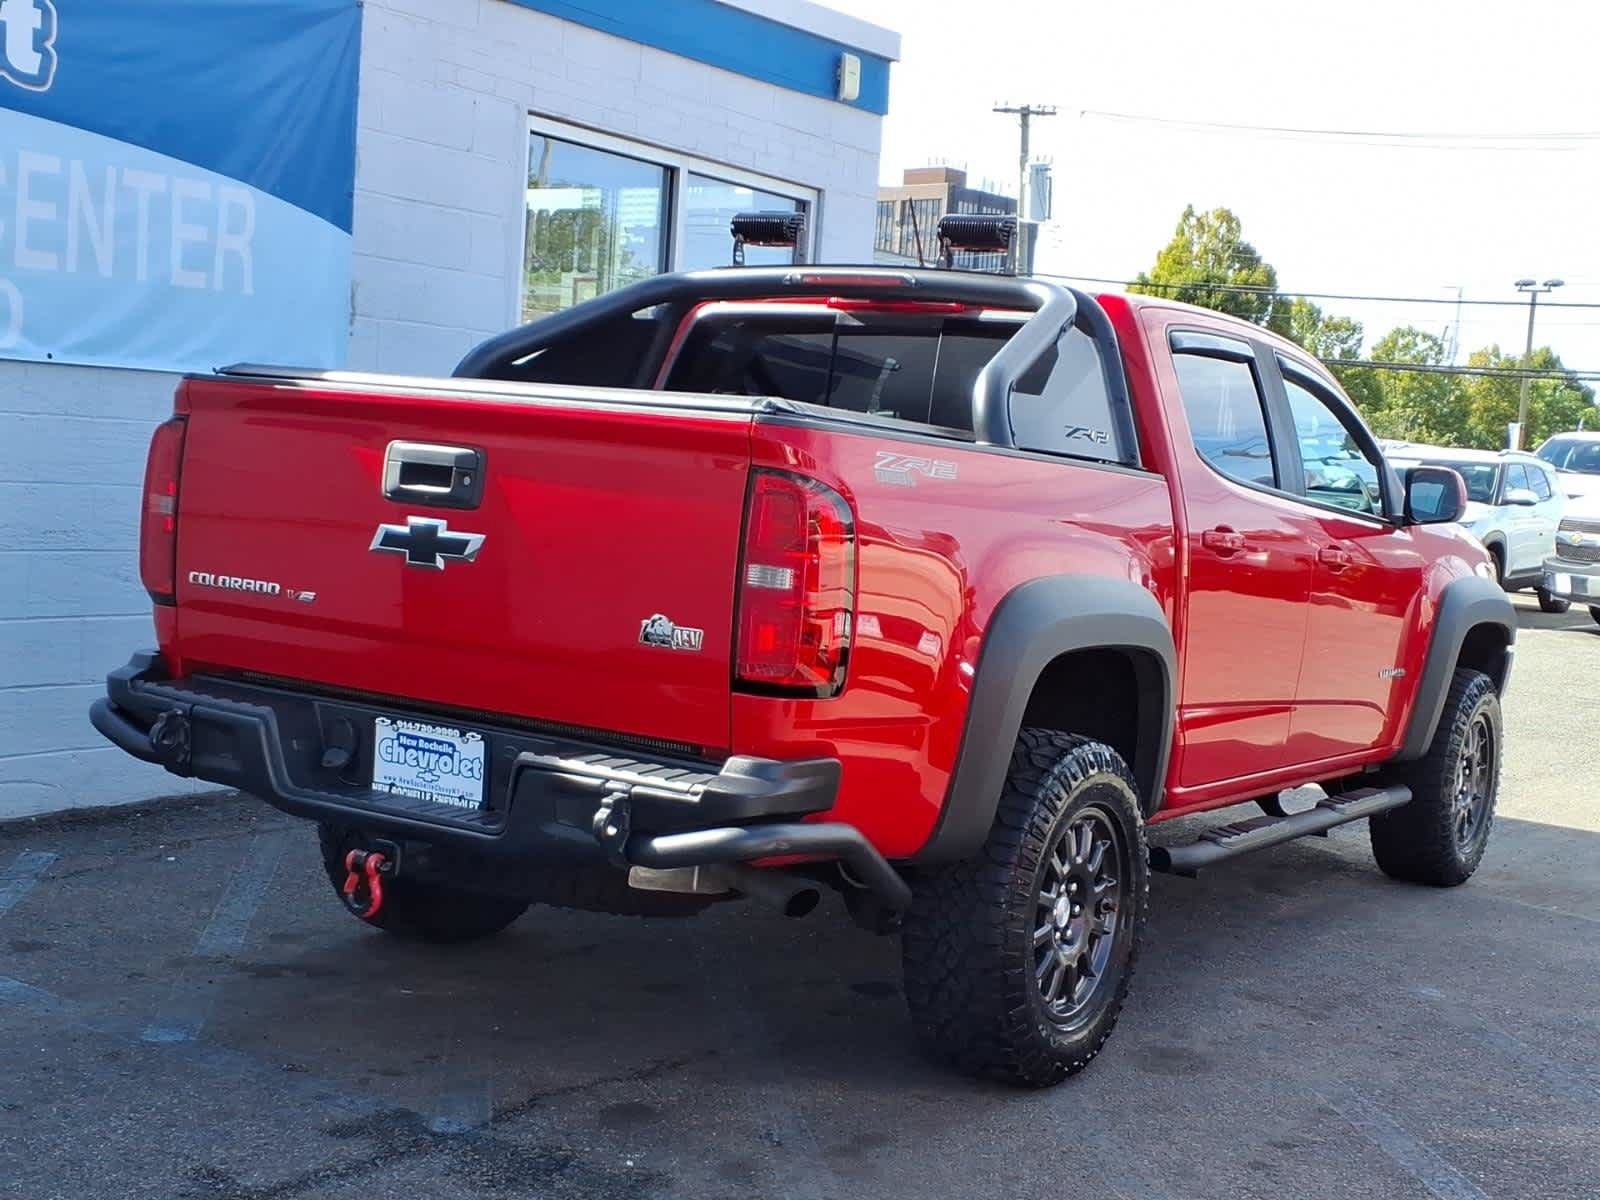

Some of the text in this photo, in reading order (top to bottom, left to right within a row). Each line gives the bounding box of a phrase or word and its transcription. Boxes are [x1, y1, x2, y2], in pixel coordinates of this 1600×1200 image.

[0, 150, 256, 295] ENTER
[874, 450, 959, 480] ZR2
[189, 571, 281, 594] COLORADO
[379, 737, 482, 781] Chevrolet
[418, 739, 454, 754] Rochelle
